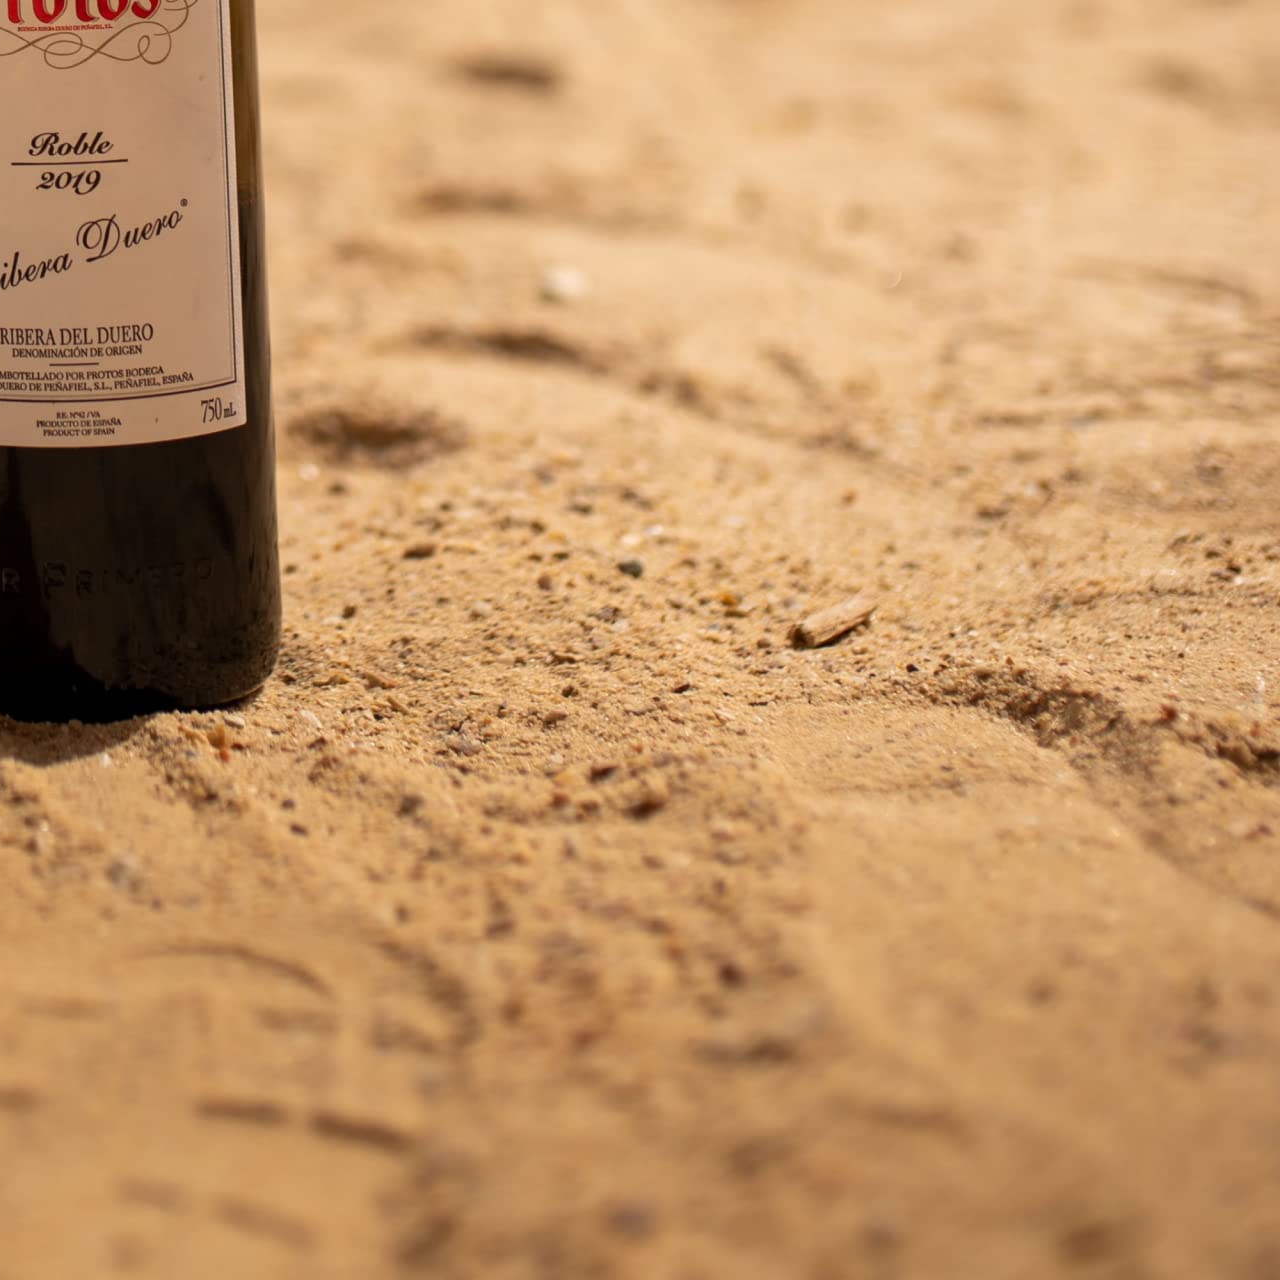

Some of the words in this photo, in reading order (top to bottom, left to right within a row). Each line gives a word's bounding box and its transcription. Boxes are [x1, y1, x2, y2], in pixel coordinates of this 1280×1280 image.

[28, 131, 113, 157] Roble
[35, 169, 102, 195] 2019
[75, 210, 183, 263] Duero
[0, 327, 56, 346] RIBERA
[59, 327, 93, 345] DEL
[96, 323, 154, 344] DUERO
[12, 347, 88, 358] DENOMINACIÓN
[90, 347, 104, 357] DE
[105, 345, 143, 356] ORIGEN
[29, 382, 42, 391] DE
[44, 381, 92, 392] PEÑAFIEL,
[114, 377, 161, 390] PEÑAFIEL,
[162, 372, 194, 385] ESPAÑA
[65, 371, 85, 381] POR
[86, 369, 124, 380] PROTOS
[125, 366, 164, 378] BODEGA
[200, 397, 222, 424] 750
[223, 402, 237, 418] mL
[36, 420, 80, 428] PRODUCTO
[81, 419, 93, 427] DE
[94, 417, 122, 426] ESPAÑA
[81, 428, 93, 436] OF
[94, 427, 115, 435] SPAIN
